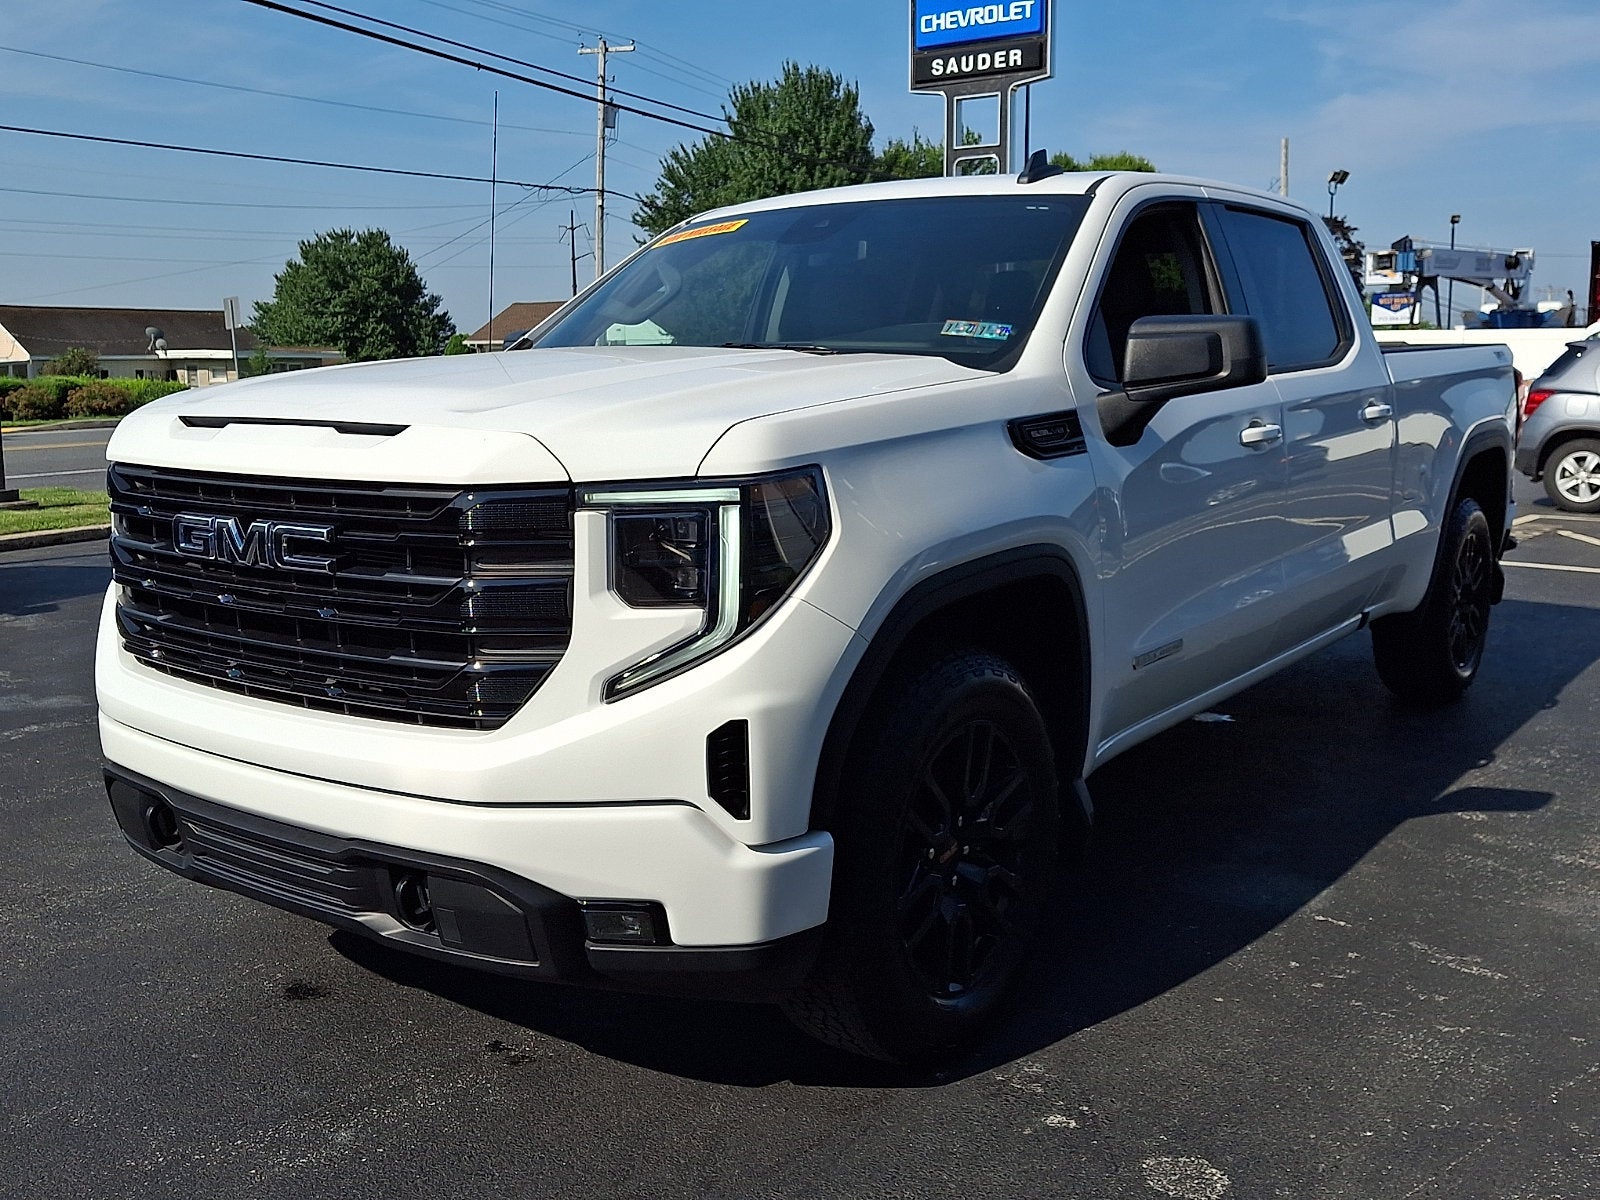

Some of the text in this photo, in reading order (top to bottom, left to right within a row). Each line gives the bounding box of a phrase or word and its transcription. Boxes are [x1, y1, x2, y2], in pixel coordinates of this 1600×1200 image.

[920, 0, 1035, 33] CHEVROLET
[931, 49, 1022, 76] SAUDER
[173, 513, 336, 574] GMC
